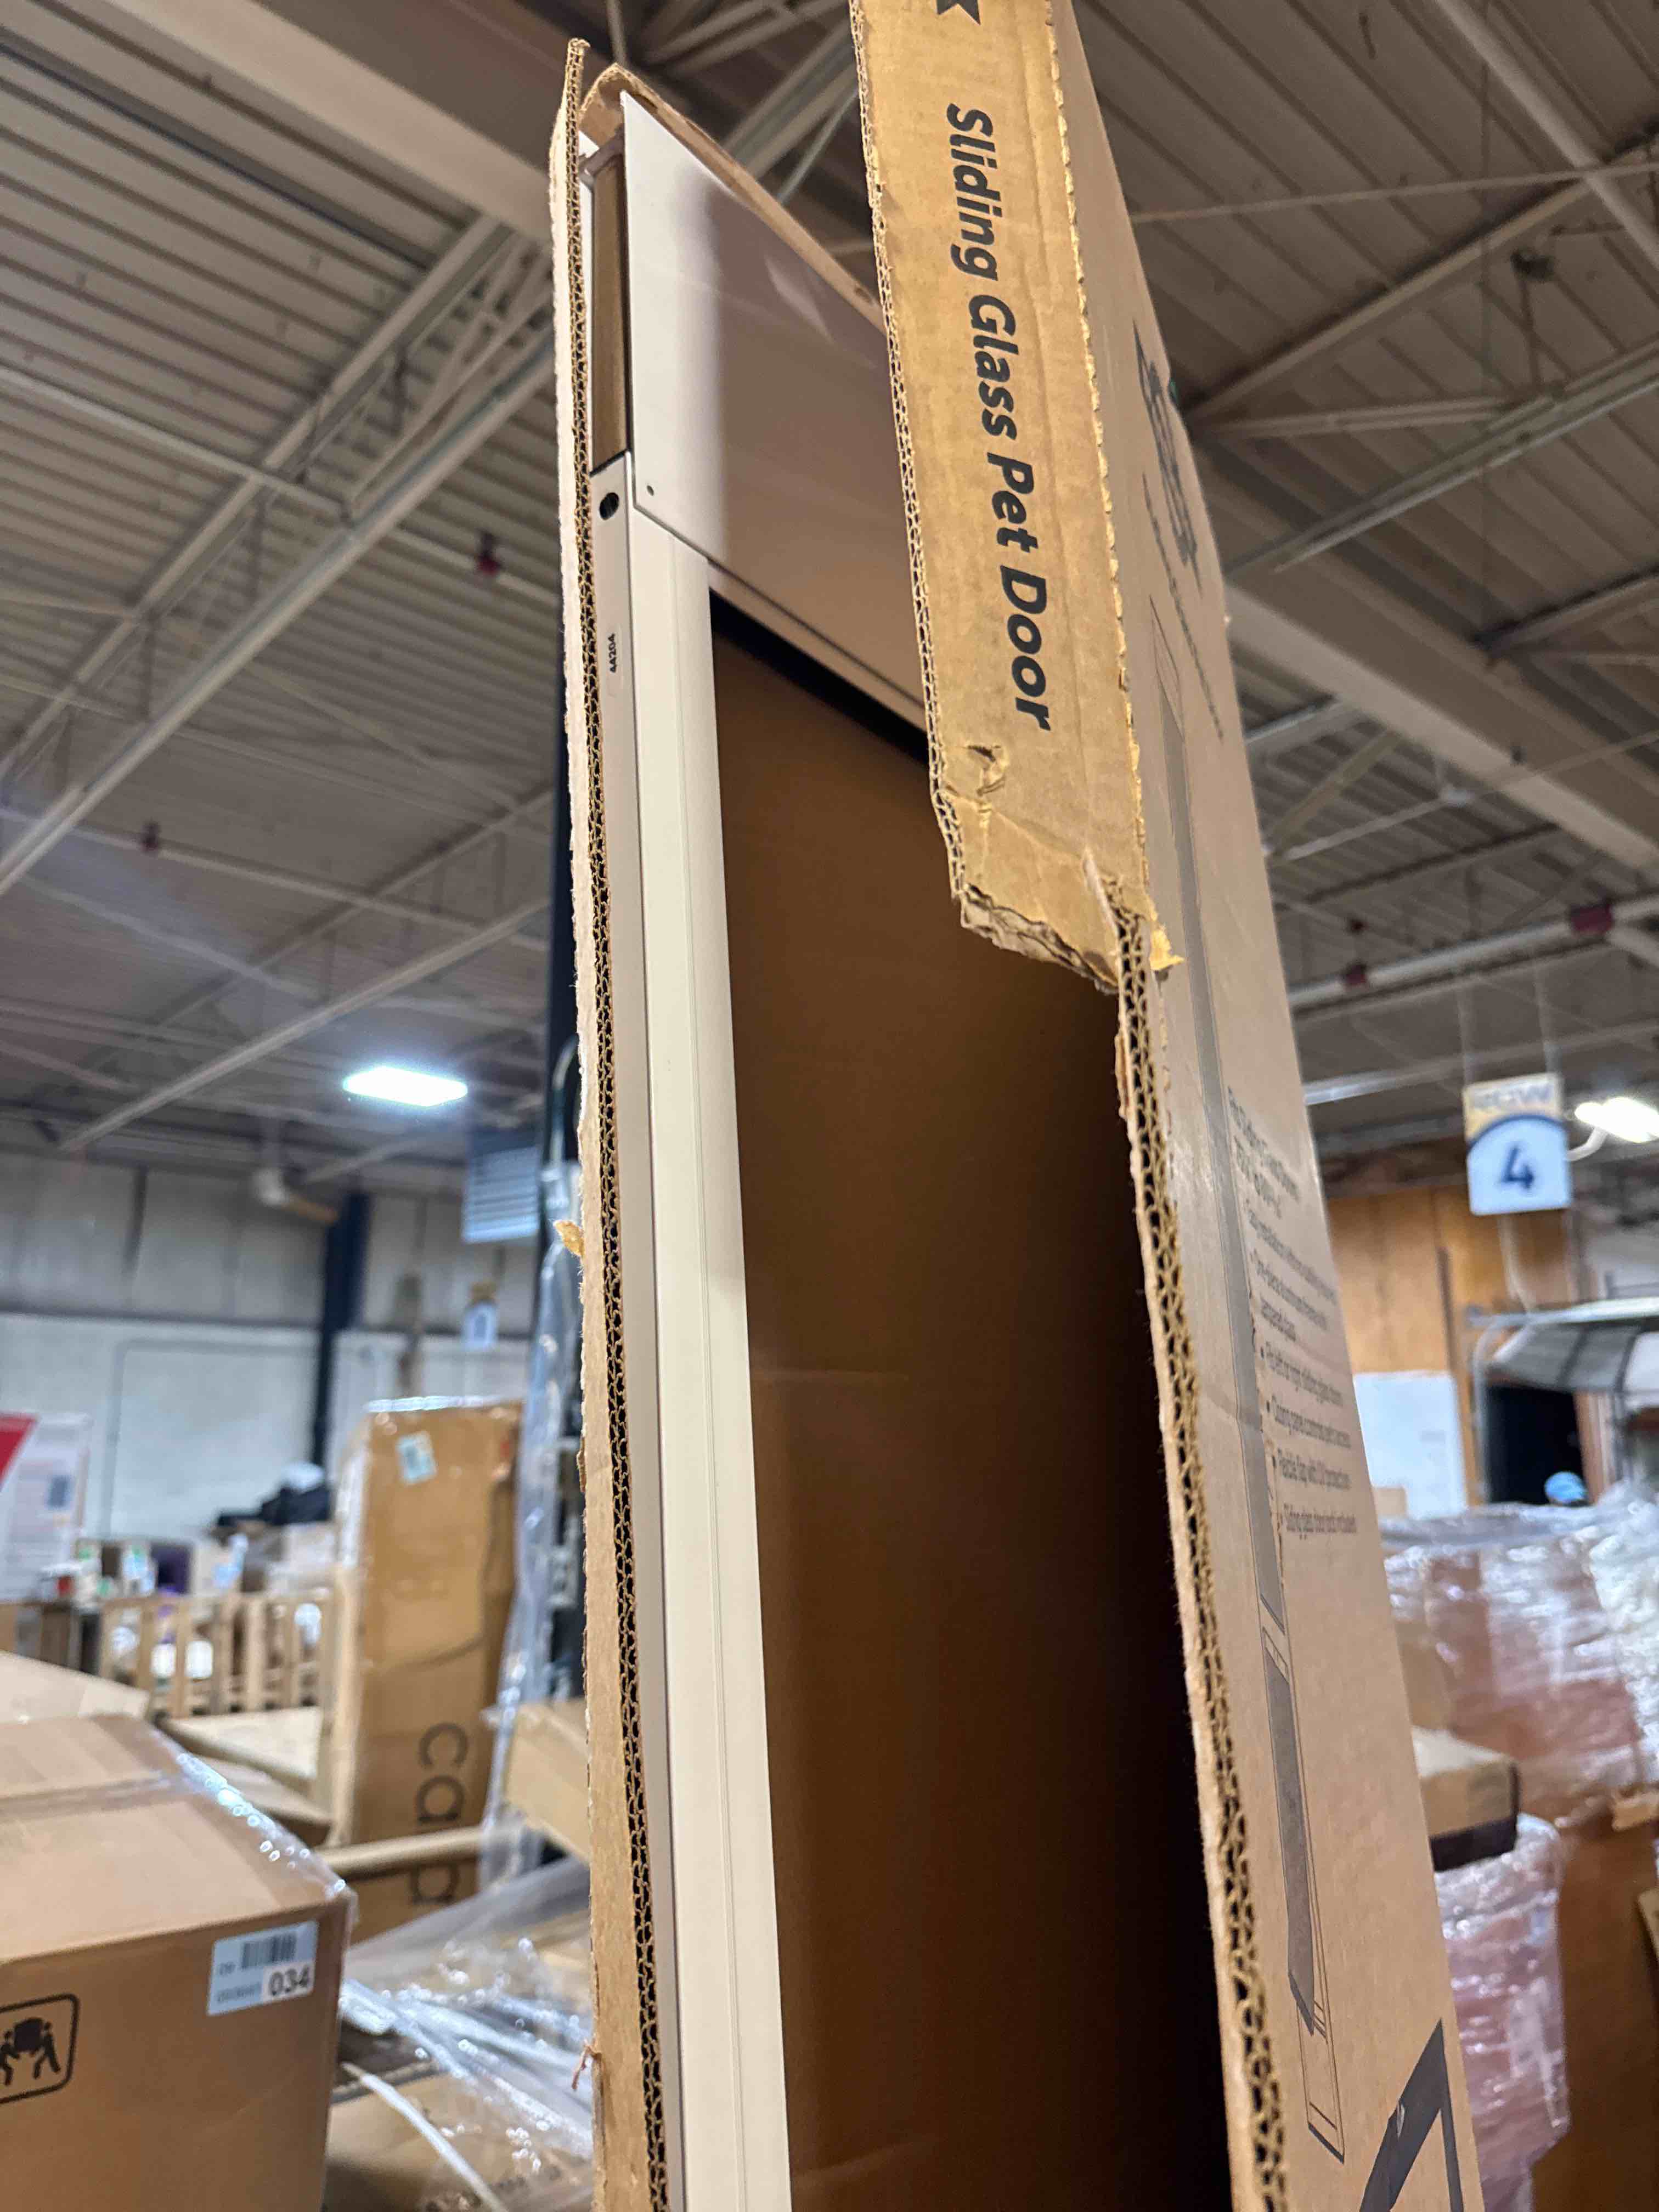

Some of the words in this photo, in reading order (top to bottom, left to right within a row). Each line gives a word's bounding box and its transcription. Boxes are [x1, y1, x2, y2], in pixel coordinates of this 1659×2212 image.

[947, 103, 1002, 281] Sliding
[969, 295, 1019, 441] Glass
[987, 452, 1038, 553] Pet
[607, 633, 617, 673] 44204
[1000, 565, 1051, 731] Door
[1501, 1146, 1536, 1190] 4
[268, 1964, 310, 1997] 034
